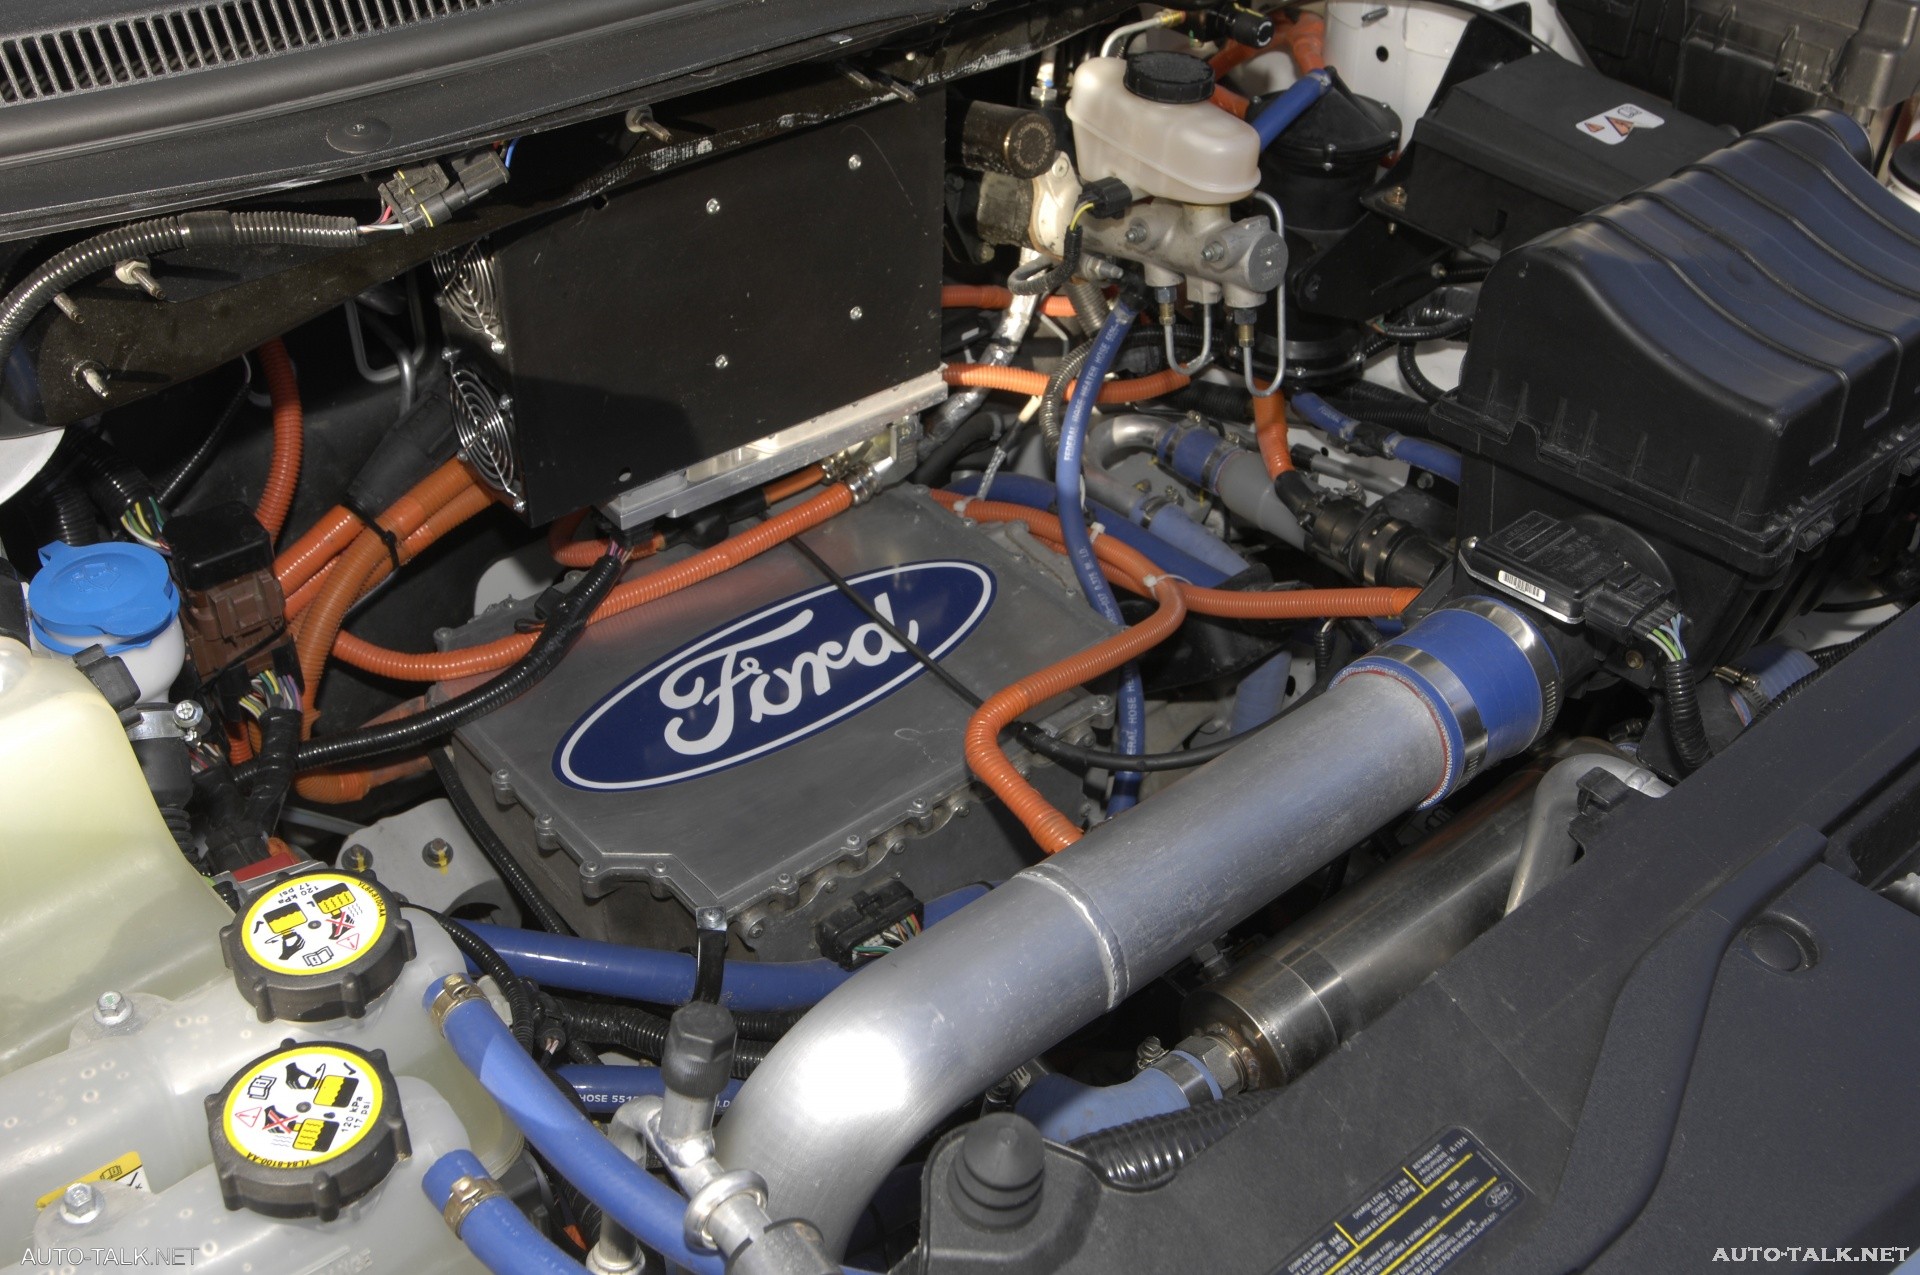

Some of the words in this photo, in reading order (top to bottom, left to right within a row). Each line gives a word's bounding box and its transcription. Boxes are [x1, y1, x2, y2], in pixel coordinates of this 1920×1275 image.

[1064, 427, 1078, 461] FEDERAL
[1080, 366, 1099, 398] HEATER
[1095, 342, 1110, 364] HOSE
[659, 592, 919, 755] Ford
[1127, 696, 1138, 725] HOSE
[279, 887, 295, 898] psi
[299, 882, 311, 891] 17
[300, 885, 320, 896] 120
[278, 894, 299, 905] kPa
[579, 1094, 608, 1103] HOSE
[341, 1115, 353, 1133] 120
[349, 1096, 363, 1114] kPa
[353, 1118, 363, 1129] 17
[361, 1101, 371, 1116] psi
